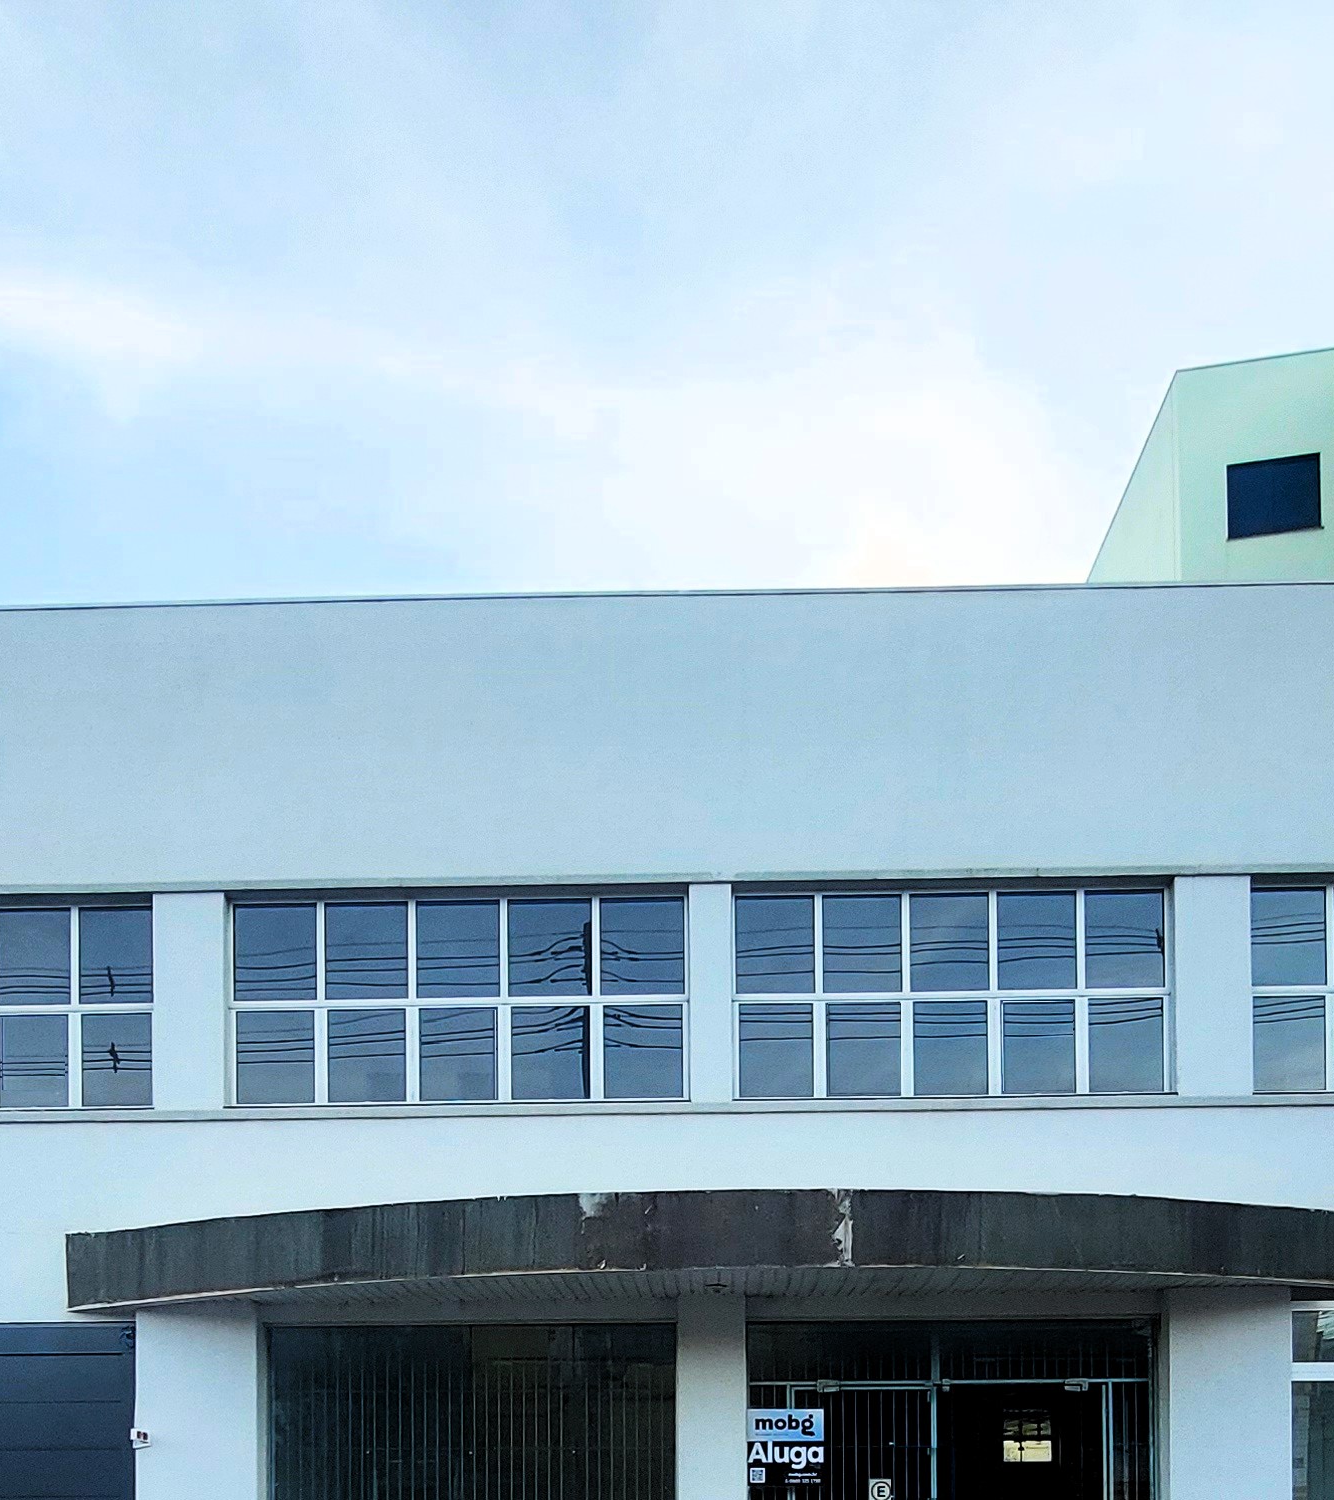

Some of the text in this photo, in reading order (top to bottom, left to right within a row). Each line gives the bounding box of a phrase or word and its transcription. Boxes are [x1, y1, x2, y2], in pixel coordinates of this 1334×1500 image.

[755, 1414, 816, 1436] mobg
[748, 1441, 824, 1469] Aluga
[876, 1485, 886, 1498] E
